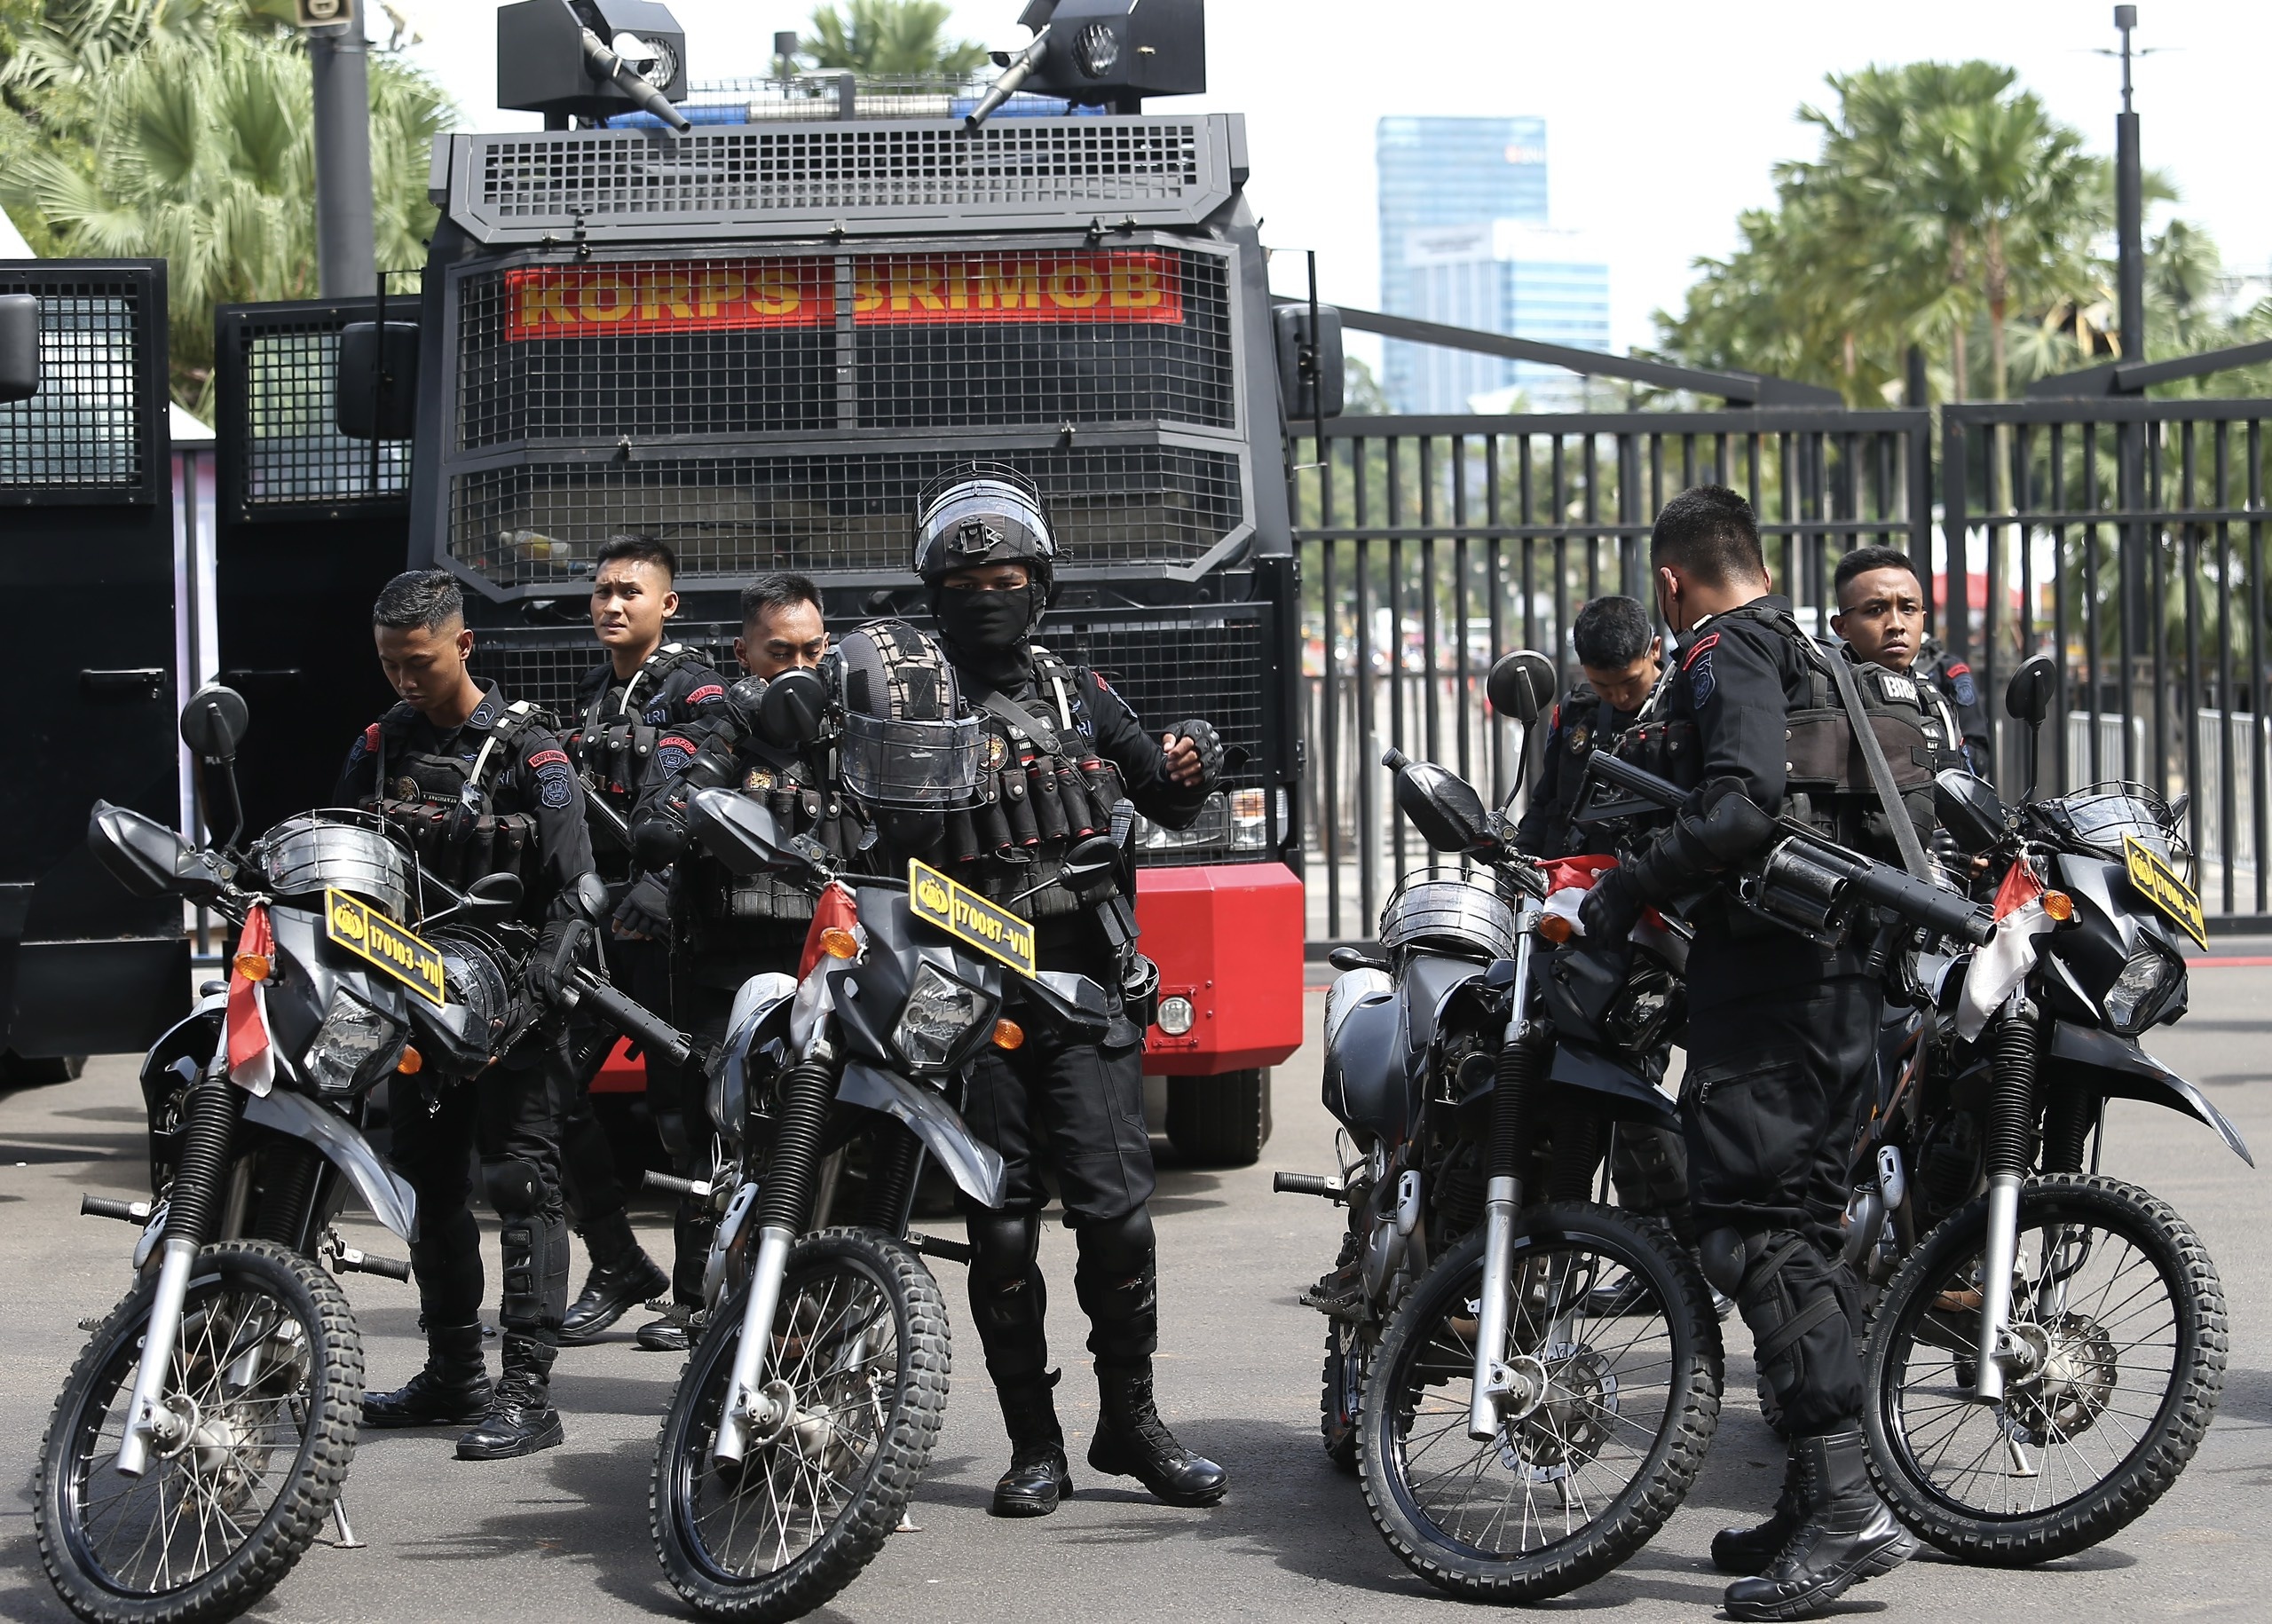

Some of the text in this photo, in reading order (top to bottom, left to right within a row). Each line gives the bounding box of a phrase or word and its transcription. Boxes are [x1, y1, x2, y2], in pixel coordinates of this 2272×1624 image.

[521, 264, 1161, 327] KORPS BRIMOB
[369, 926, 439, 988] 170103-VII
[954, 898, 1030, 959] 170087-VII
